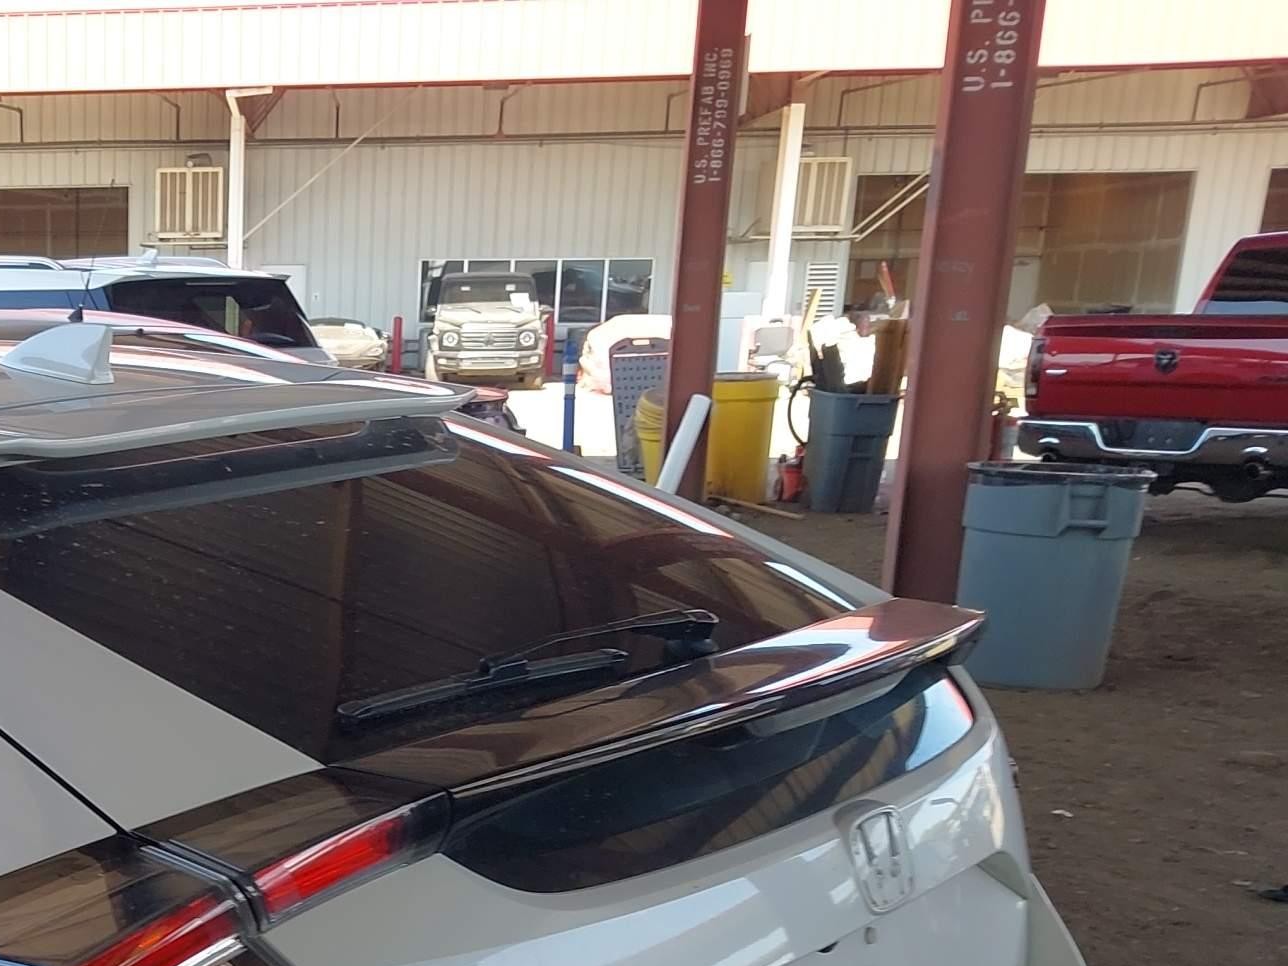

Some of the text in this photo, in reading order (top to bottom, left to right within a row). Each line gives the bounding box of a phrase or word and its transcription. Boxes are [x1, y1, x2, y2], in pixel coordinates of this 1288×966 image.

[962, 40, 990, 92] U.S.
[693, 47, 719, 184] U.S. PREFAB INC.
